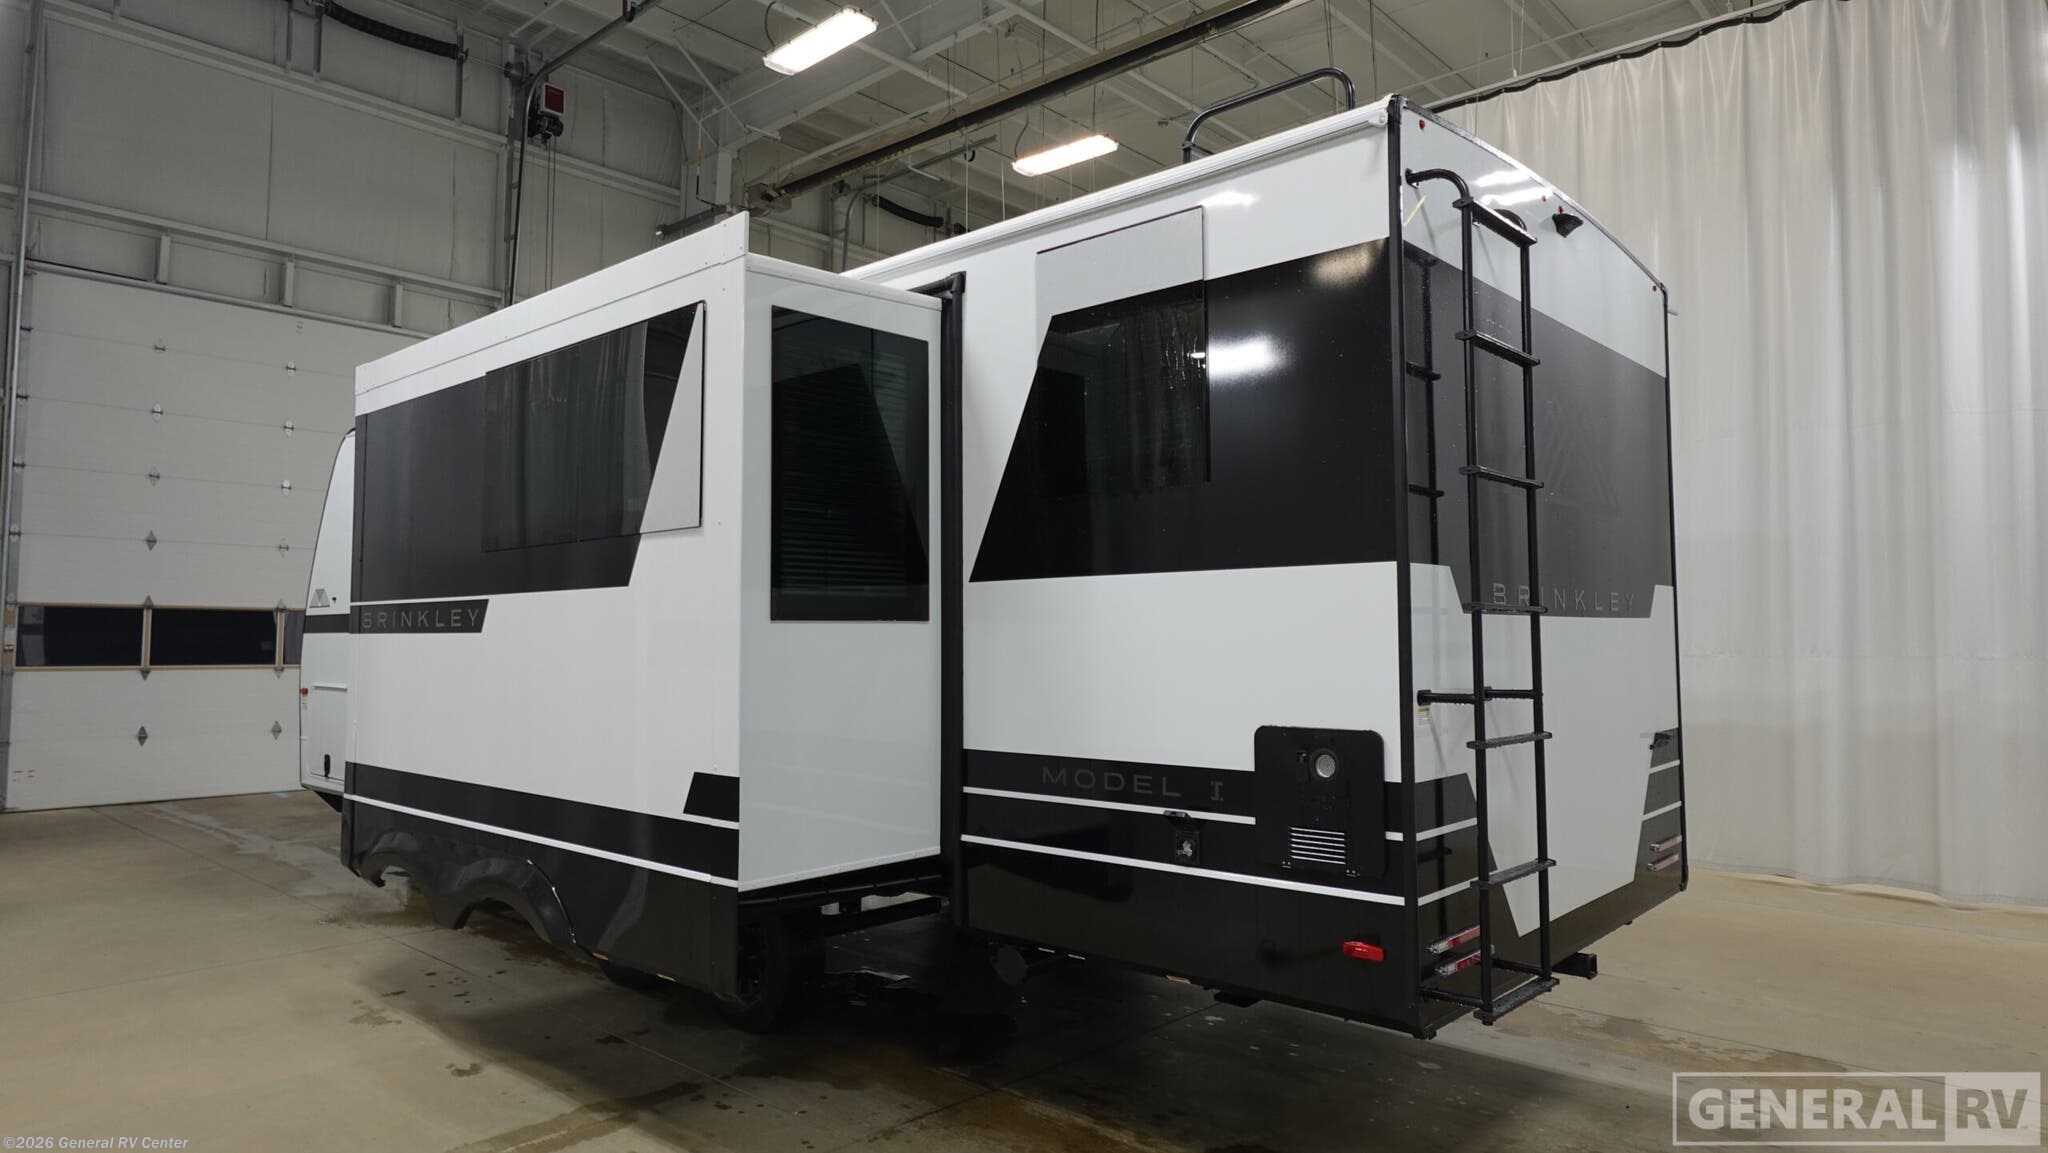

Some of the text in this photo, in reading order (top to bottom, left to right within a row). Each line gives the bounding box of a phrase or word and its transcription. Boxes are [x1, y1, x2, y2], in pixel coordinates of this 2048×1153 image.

[1493, 582, 1634, 612] BRINKLEY
[361, 608, 479, 629] BRINKLEY
[1042, 767, 1224, 801] MODEL I
